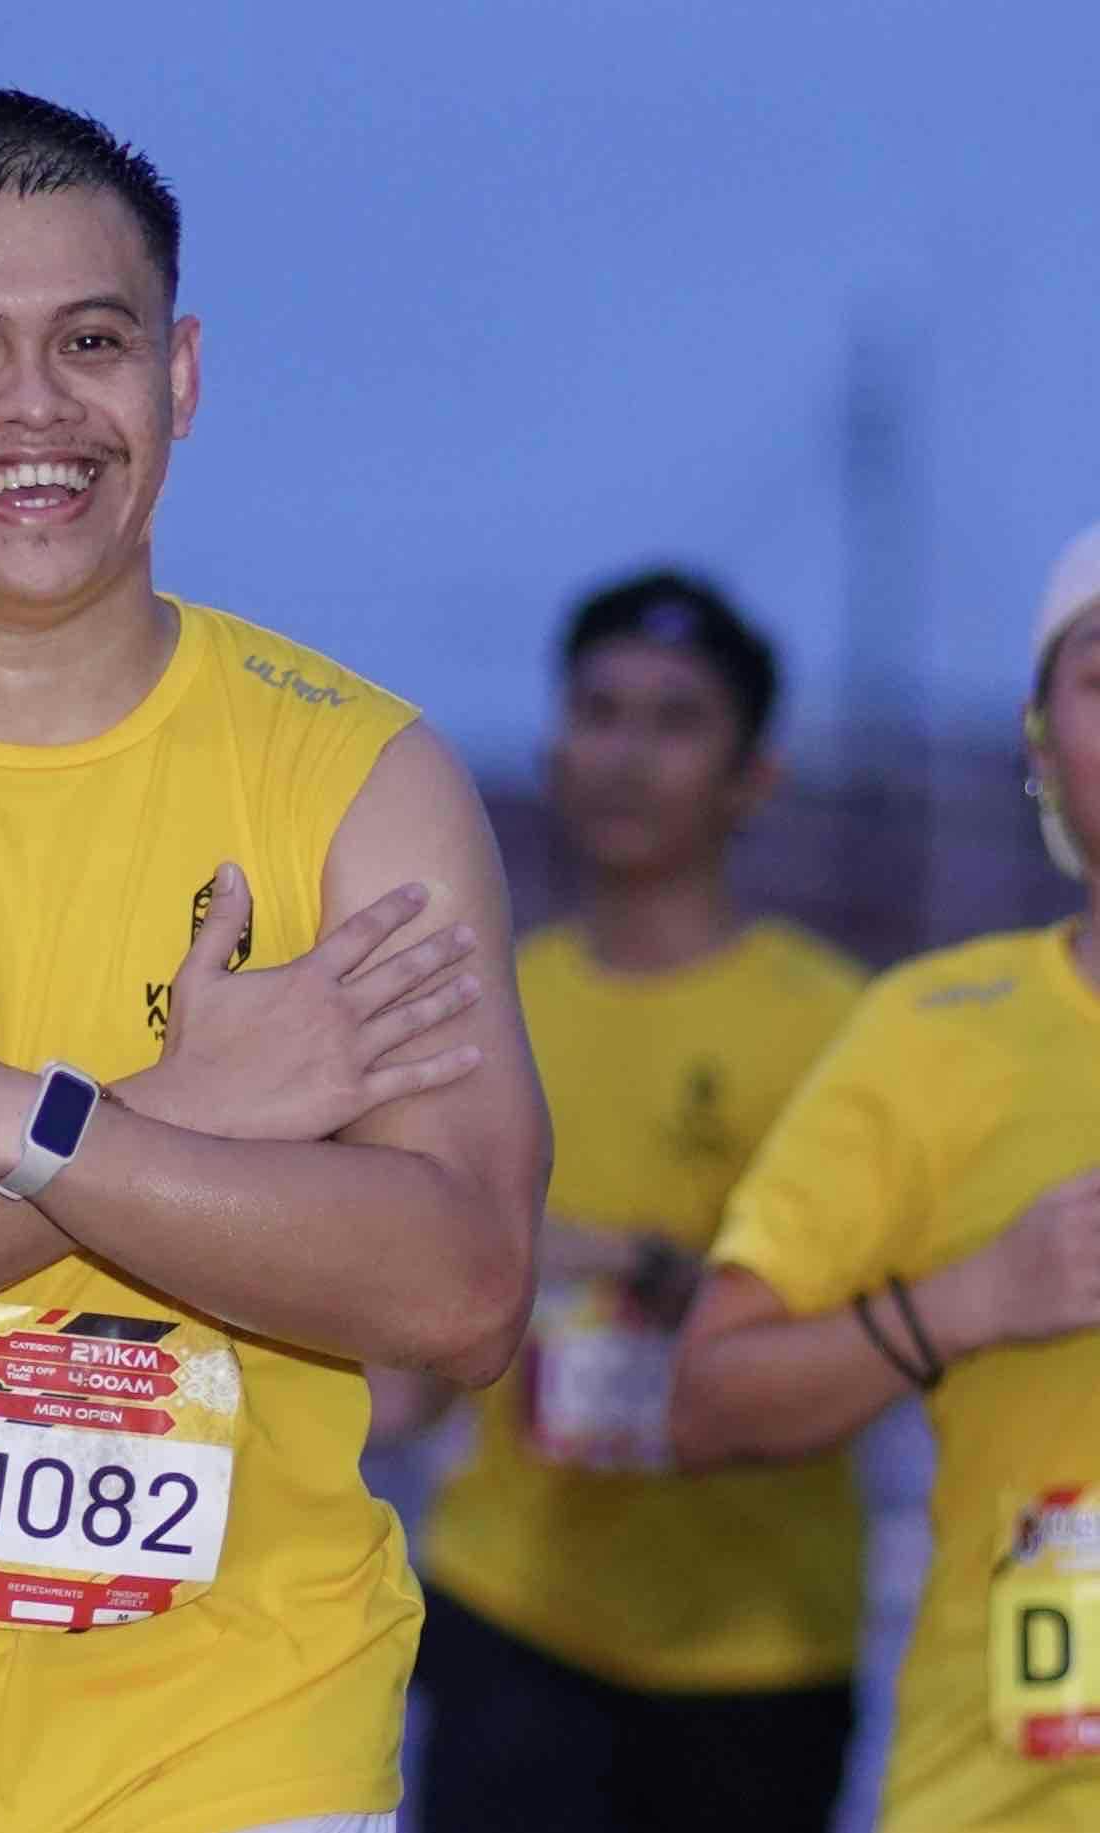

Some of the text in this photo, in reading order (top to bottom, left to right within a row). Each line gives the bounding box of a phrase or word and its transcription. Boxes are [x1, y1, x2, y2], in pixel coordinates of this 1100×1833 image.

[9, 1340, 67, 1353] CATEGORY
[6, 1363, 57, 1377] FLAG OFF
[68, 1371, 155, 1395] 4:00AM
[33, 1403, 124, 1425] MEN OPEN
[1019, 1607, 1071, 1683] D
